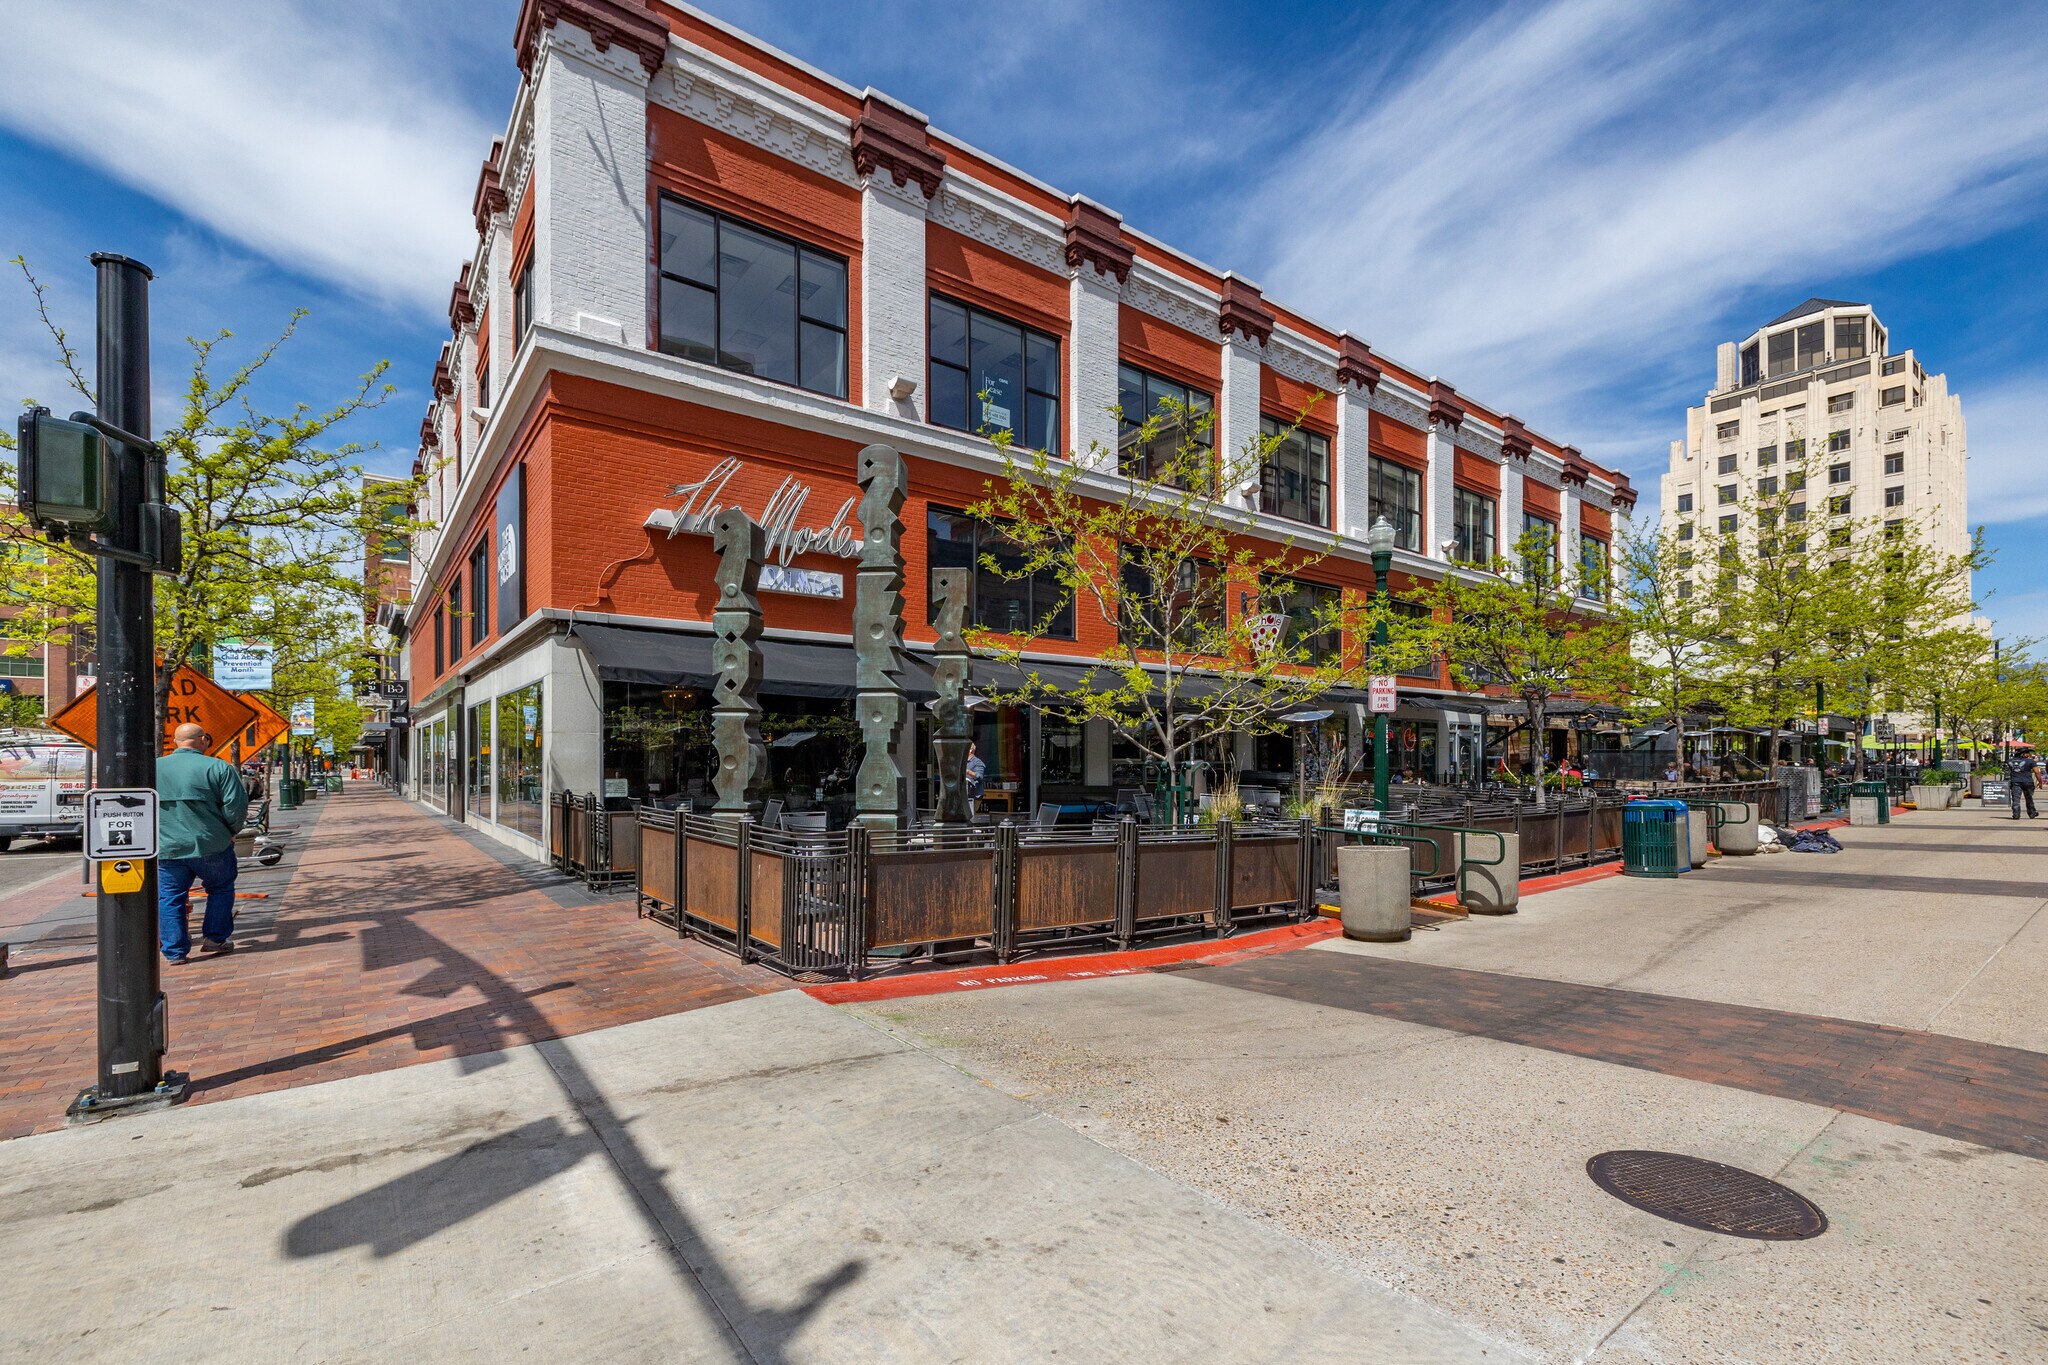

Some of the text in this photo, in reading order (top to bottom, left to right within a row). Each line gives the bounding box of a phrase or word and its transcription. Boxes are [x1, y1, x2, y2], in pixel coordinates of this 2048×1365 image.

[664, 456, 743, 540] Th
[957, 979, 982, 987] NO
[985, 974, 1048, 984] PARKING
